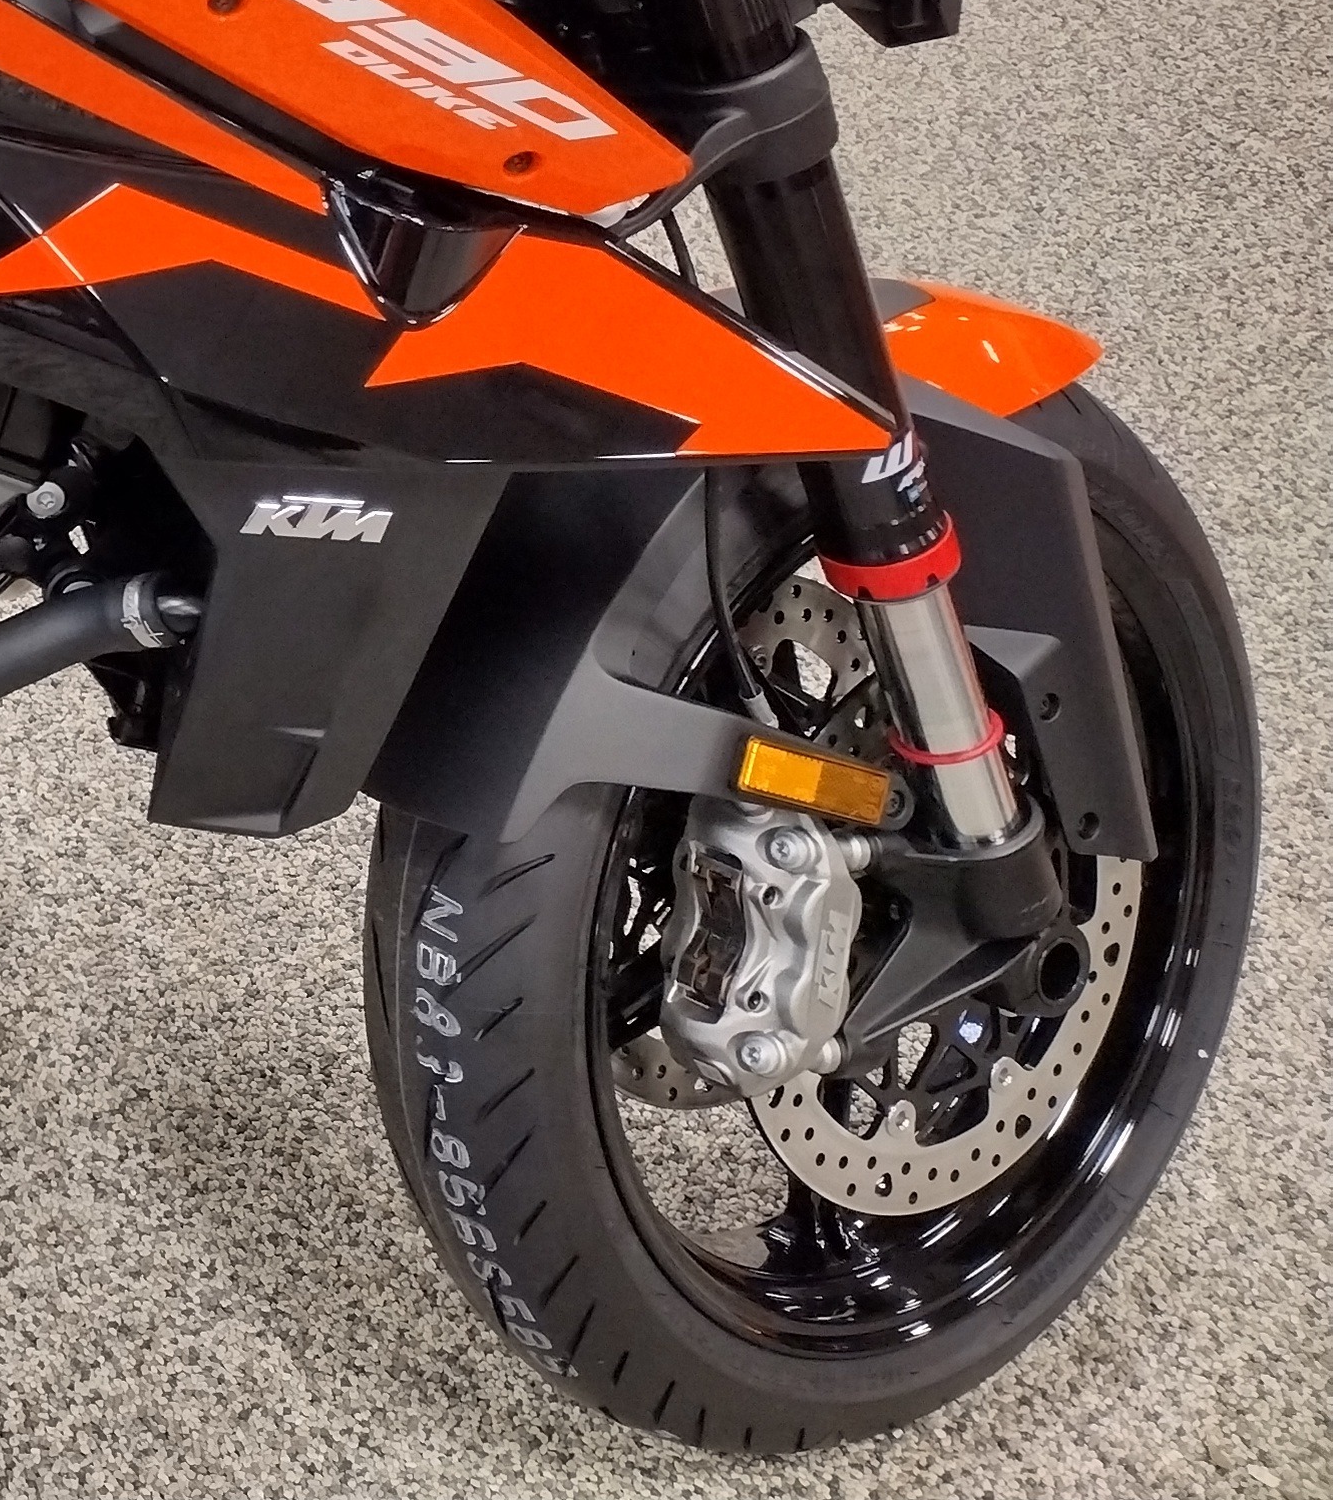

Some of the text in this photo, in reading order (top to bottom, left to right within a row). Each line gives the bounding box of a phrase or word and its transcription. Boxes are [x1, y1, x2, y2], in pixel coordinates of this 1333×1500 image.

[319, 38, 518, 130] DUKE
[239, 495, 394, 544] KTM
[815, 908, 853, 1009] KTM
